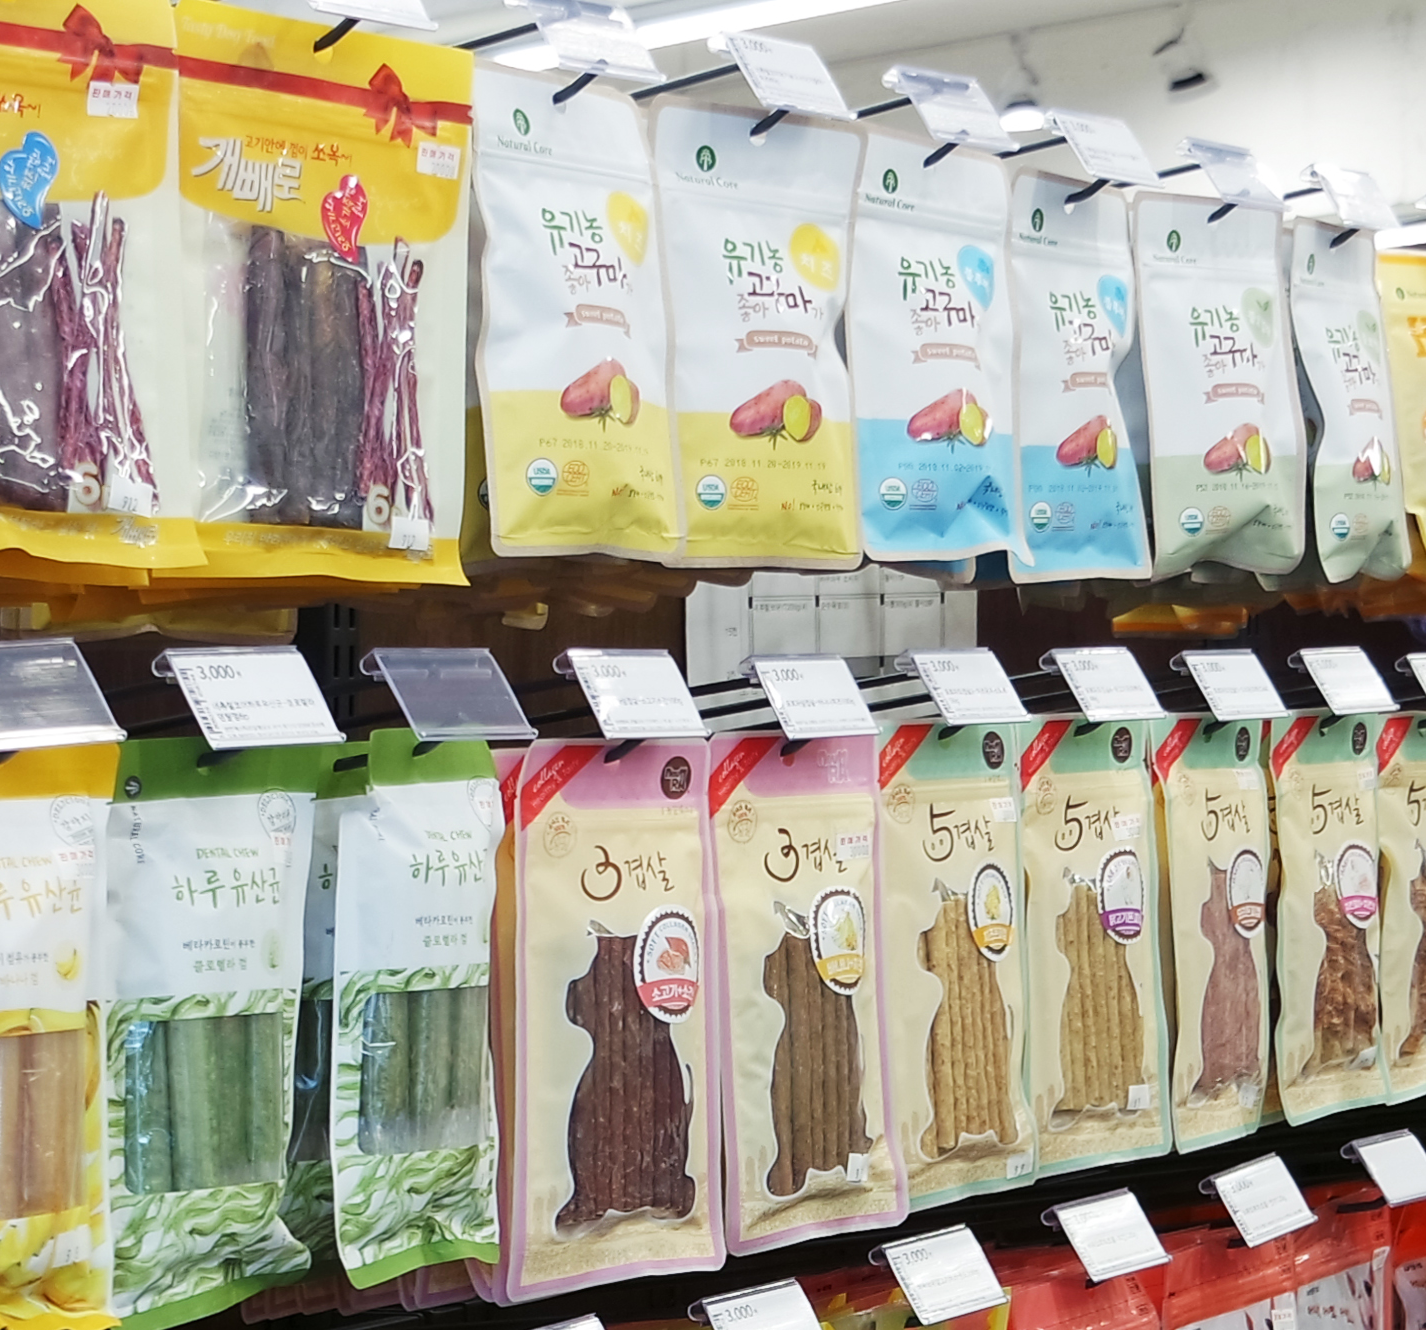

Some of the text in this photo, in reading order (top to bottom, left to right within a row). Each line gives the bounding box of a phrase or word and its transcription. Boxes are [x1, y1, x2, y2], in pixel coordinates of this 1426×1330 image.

[244, 136, 286, 156] 고기안에
[497, 134, 553, 157] Natural Core
[191, 137, 306, 213] 개빼로
[676, 172, 739, 190] Natural Core
[864, 192, 915, 213] Natural Core
[541, 208, 603, 255] 유기농
[723, 238, 784, 285] 유기농
[898, 256, 956, 301] 유기농
[1048, 291, 1096, 332] 유기농
[1189, 305, 1240, 347] 유기농
[753, 334, 808, 346] sweet potato
[532, 759, 565, 794] collagen
[718, 752, 746, 783] collagen
[1201, 788, 1251, 842] 5겹살
[1309, 783, 1365, 835] 5겹살
[922, 803, 995, 862] 5겹살
[196, 847, 259, 860] DENTAL CHEW
[580, 844, 675, 902] 3겹살
